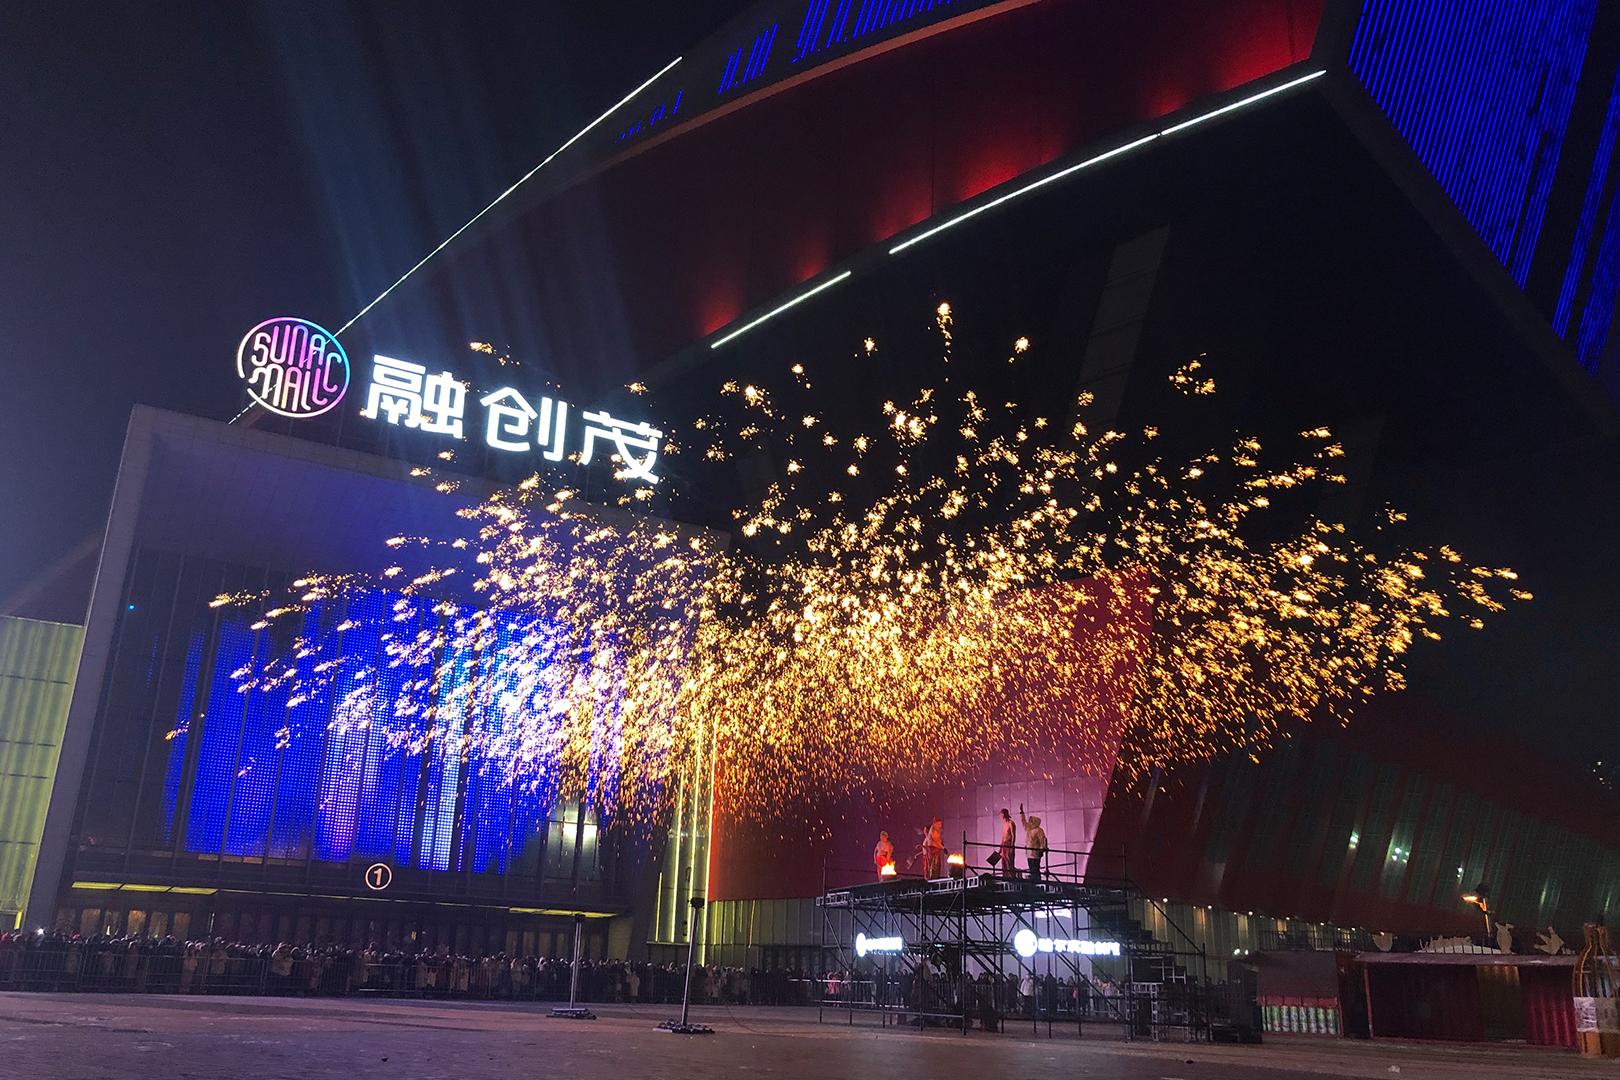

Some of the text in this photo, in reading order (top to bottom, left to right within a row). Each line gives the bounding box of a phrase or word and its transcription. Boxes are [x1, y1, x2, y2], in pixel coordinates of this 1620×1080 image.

[248, 363, 328, 412] MALL
[252, 324, 342, 393] SUNAC
[366, 354, 663, 485] 融创茂
